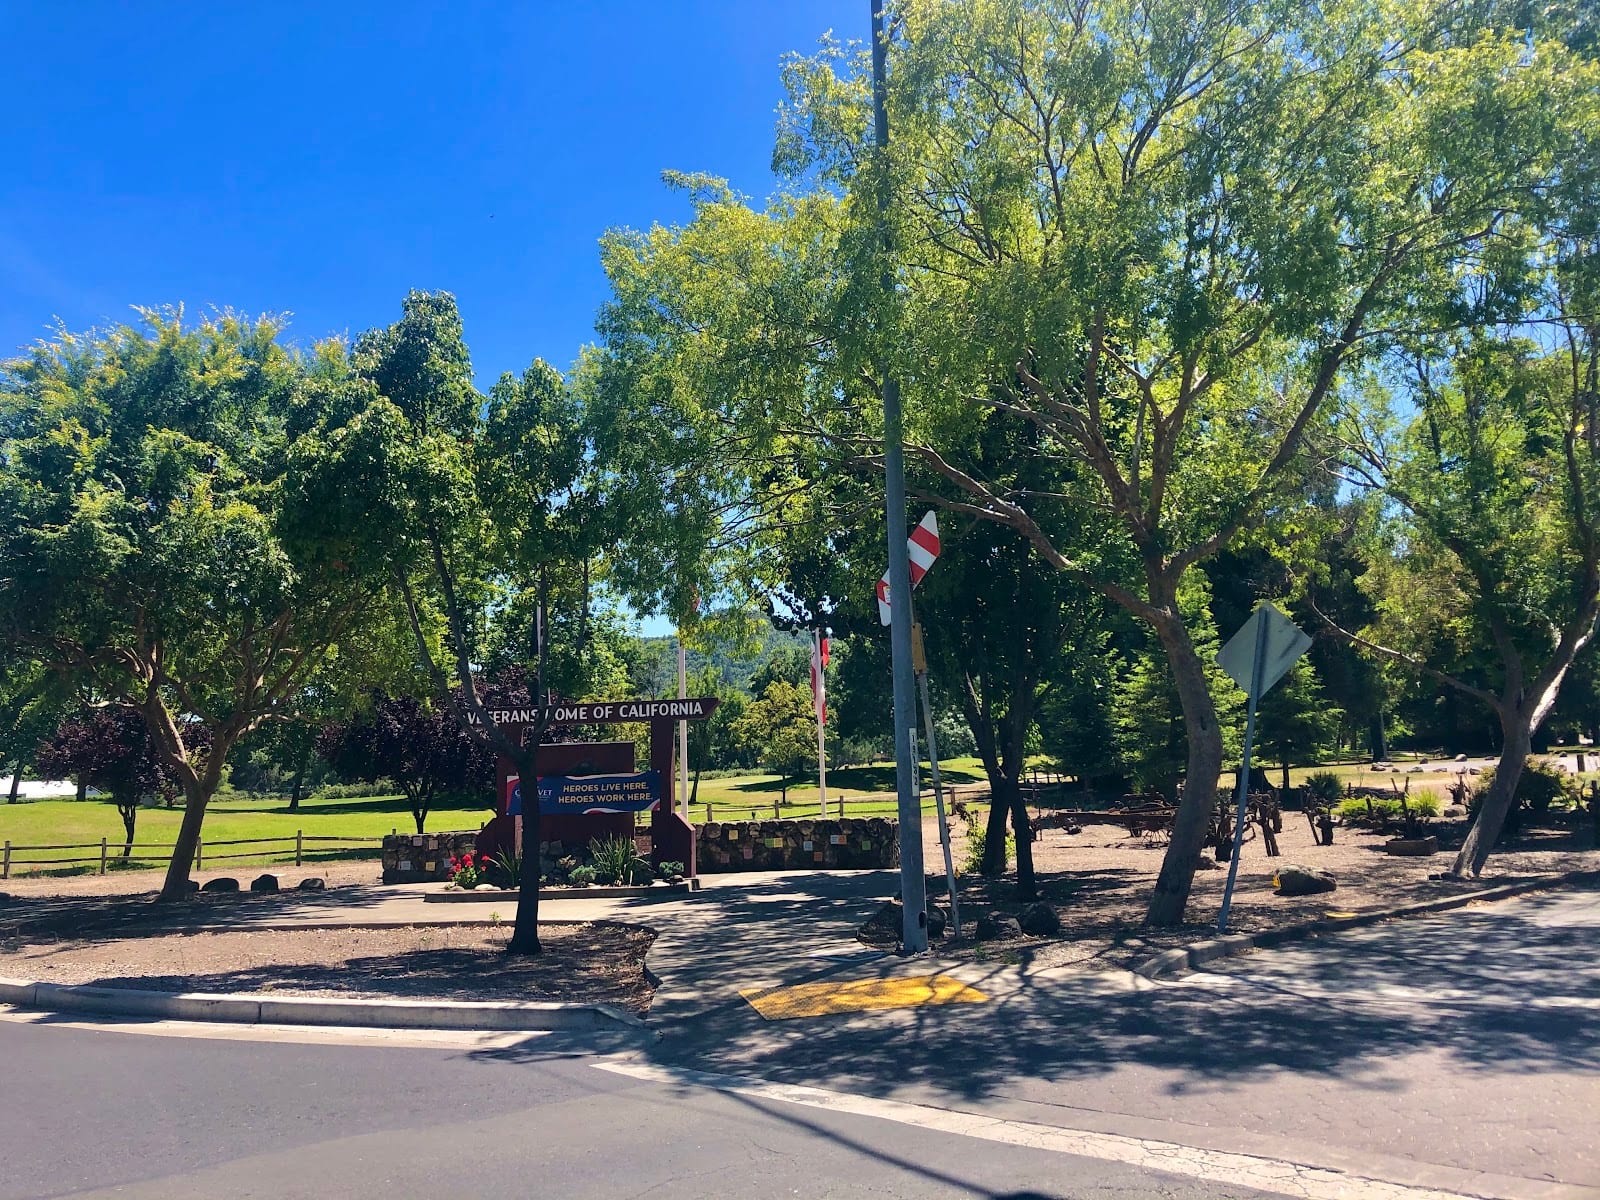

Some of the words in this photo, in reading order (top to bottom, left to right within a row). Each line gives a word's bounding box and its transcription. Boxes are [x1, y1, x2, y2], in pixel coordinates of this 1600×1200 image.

[593, 705, 614, 719] OF
[619, 701, 703, 718] CALIFORNIA
[562, 784, 599, 793] HEROES
[601, 783, 621, 791] LIVE
[623, 782, 649, 790] HERE.
[558, 795, 594, 804] HEROES
[596, 794, 625, 802] WORK
[627, 793, 653, 801] HERE.
